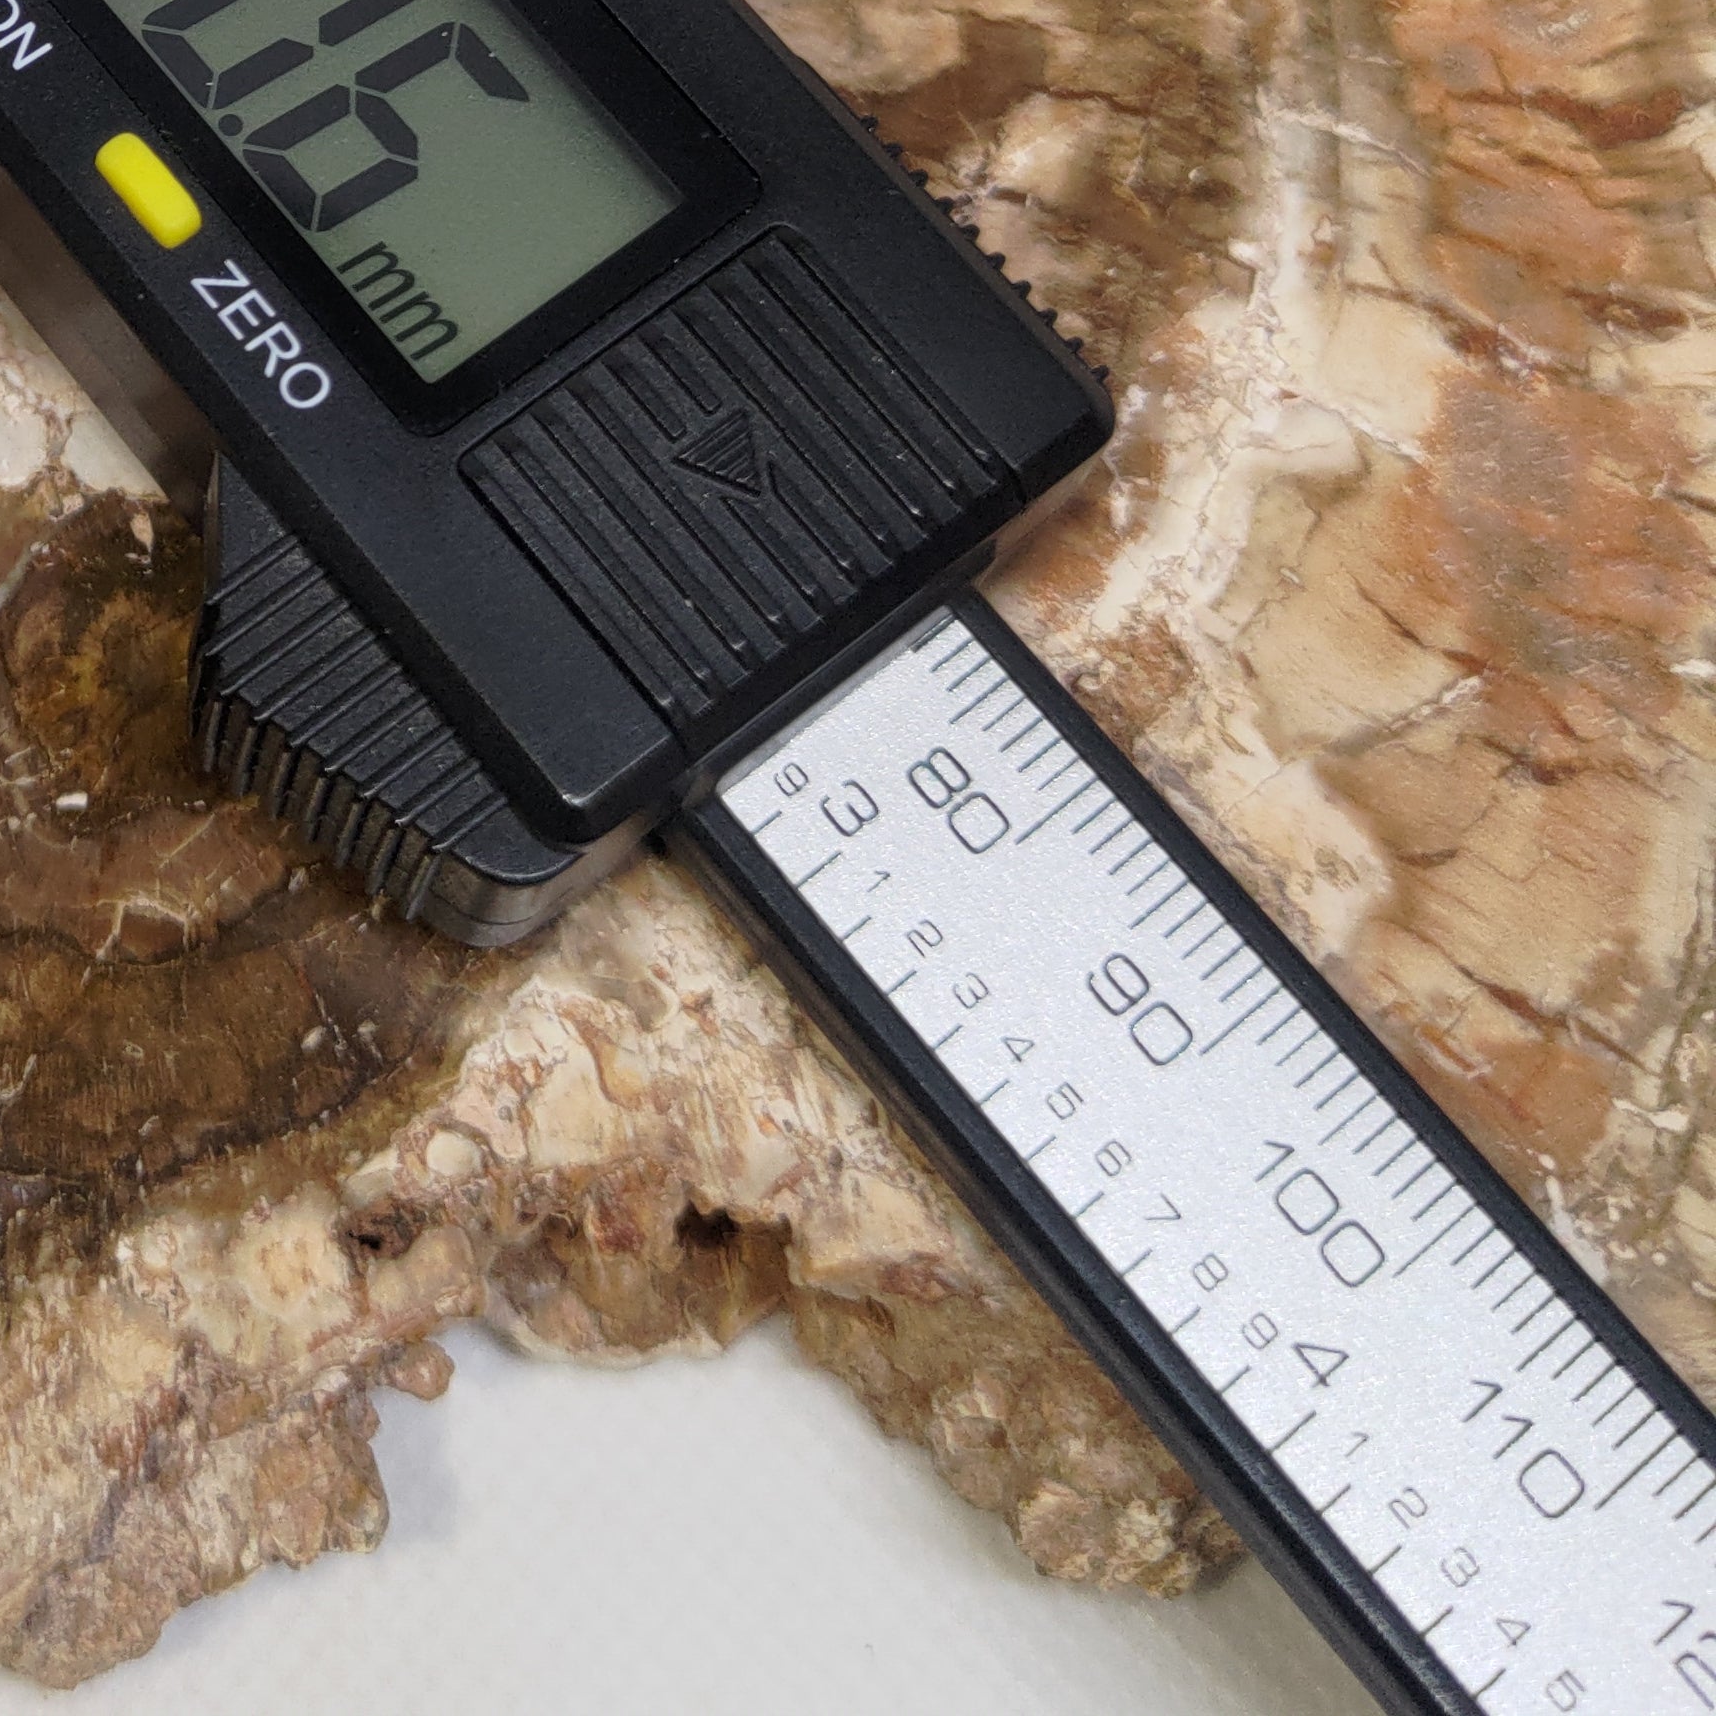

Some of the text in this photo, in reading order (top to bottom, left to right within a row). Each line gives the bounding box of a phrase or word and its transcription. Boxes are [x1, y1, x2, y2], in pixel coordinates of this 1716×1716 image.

[189, 258, 332, 411] ZERO
[336, 240, 463, 362] mm
[772, 761, 1587, 1714] 9 3 1 2 3 4 5 6 7 8 9 4 1 2 3 4 5
[904, 745, 1012, 856] 80
[1084, 951, 1195, 1069] 90
[1253, 1139, 1388, 1290] 100
[1460, 1378, 1587, 1522] 110
